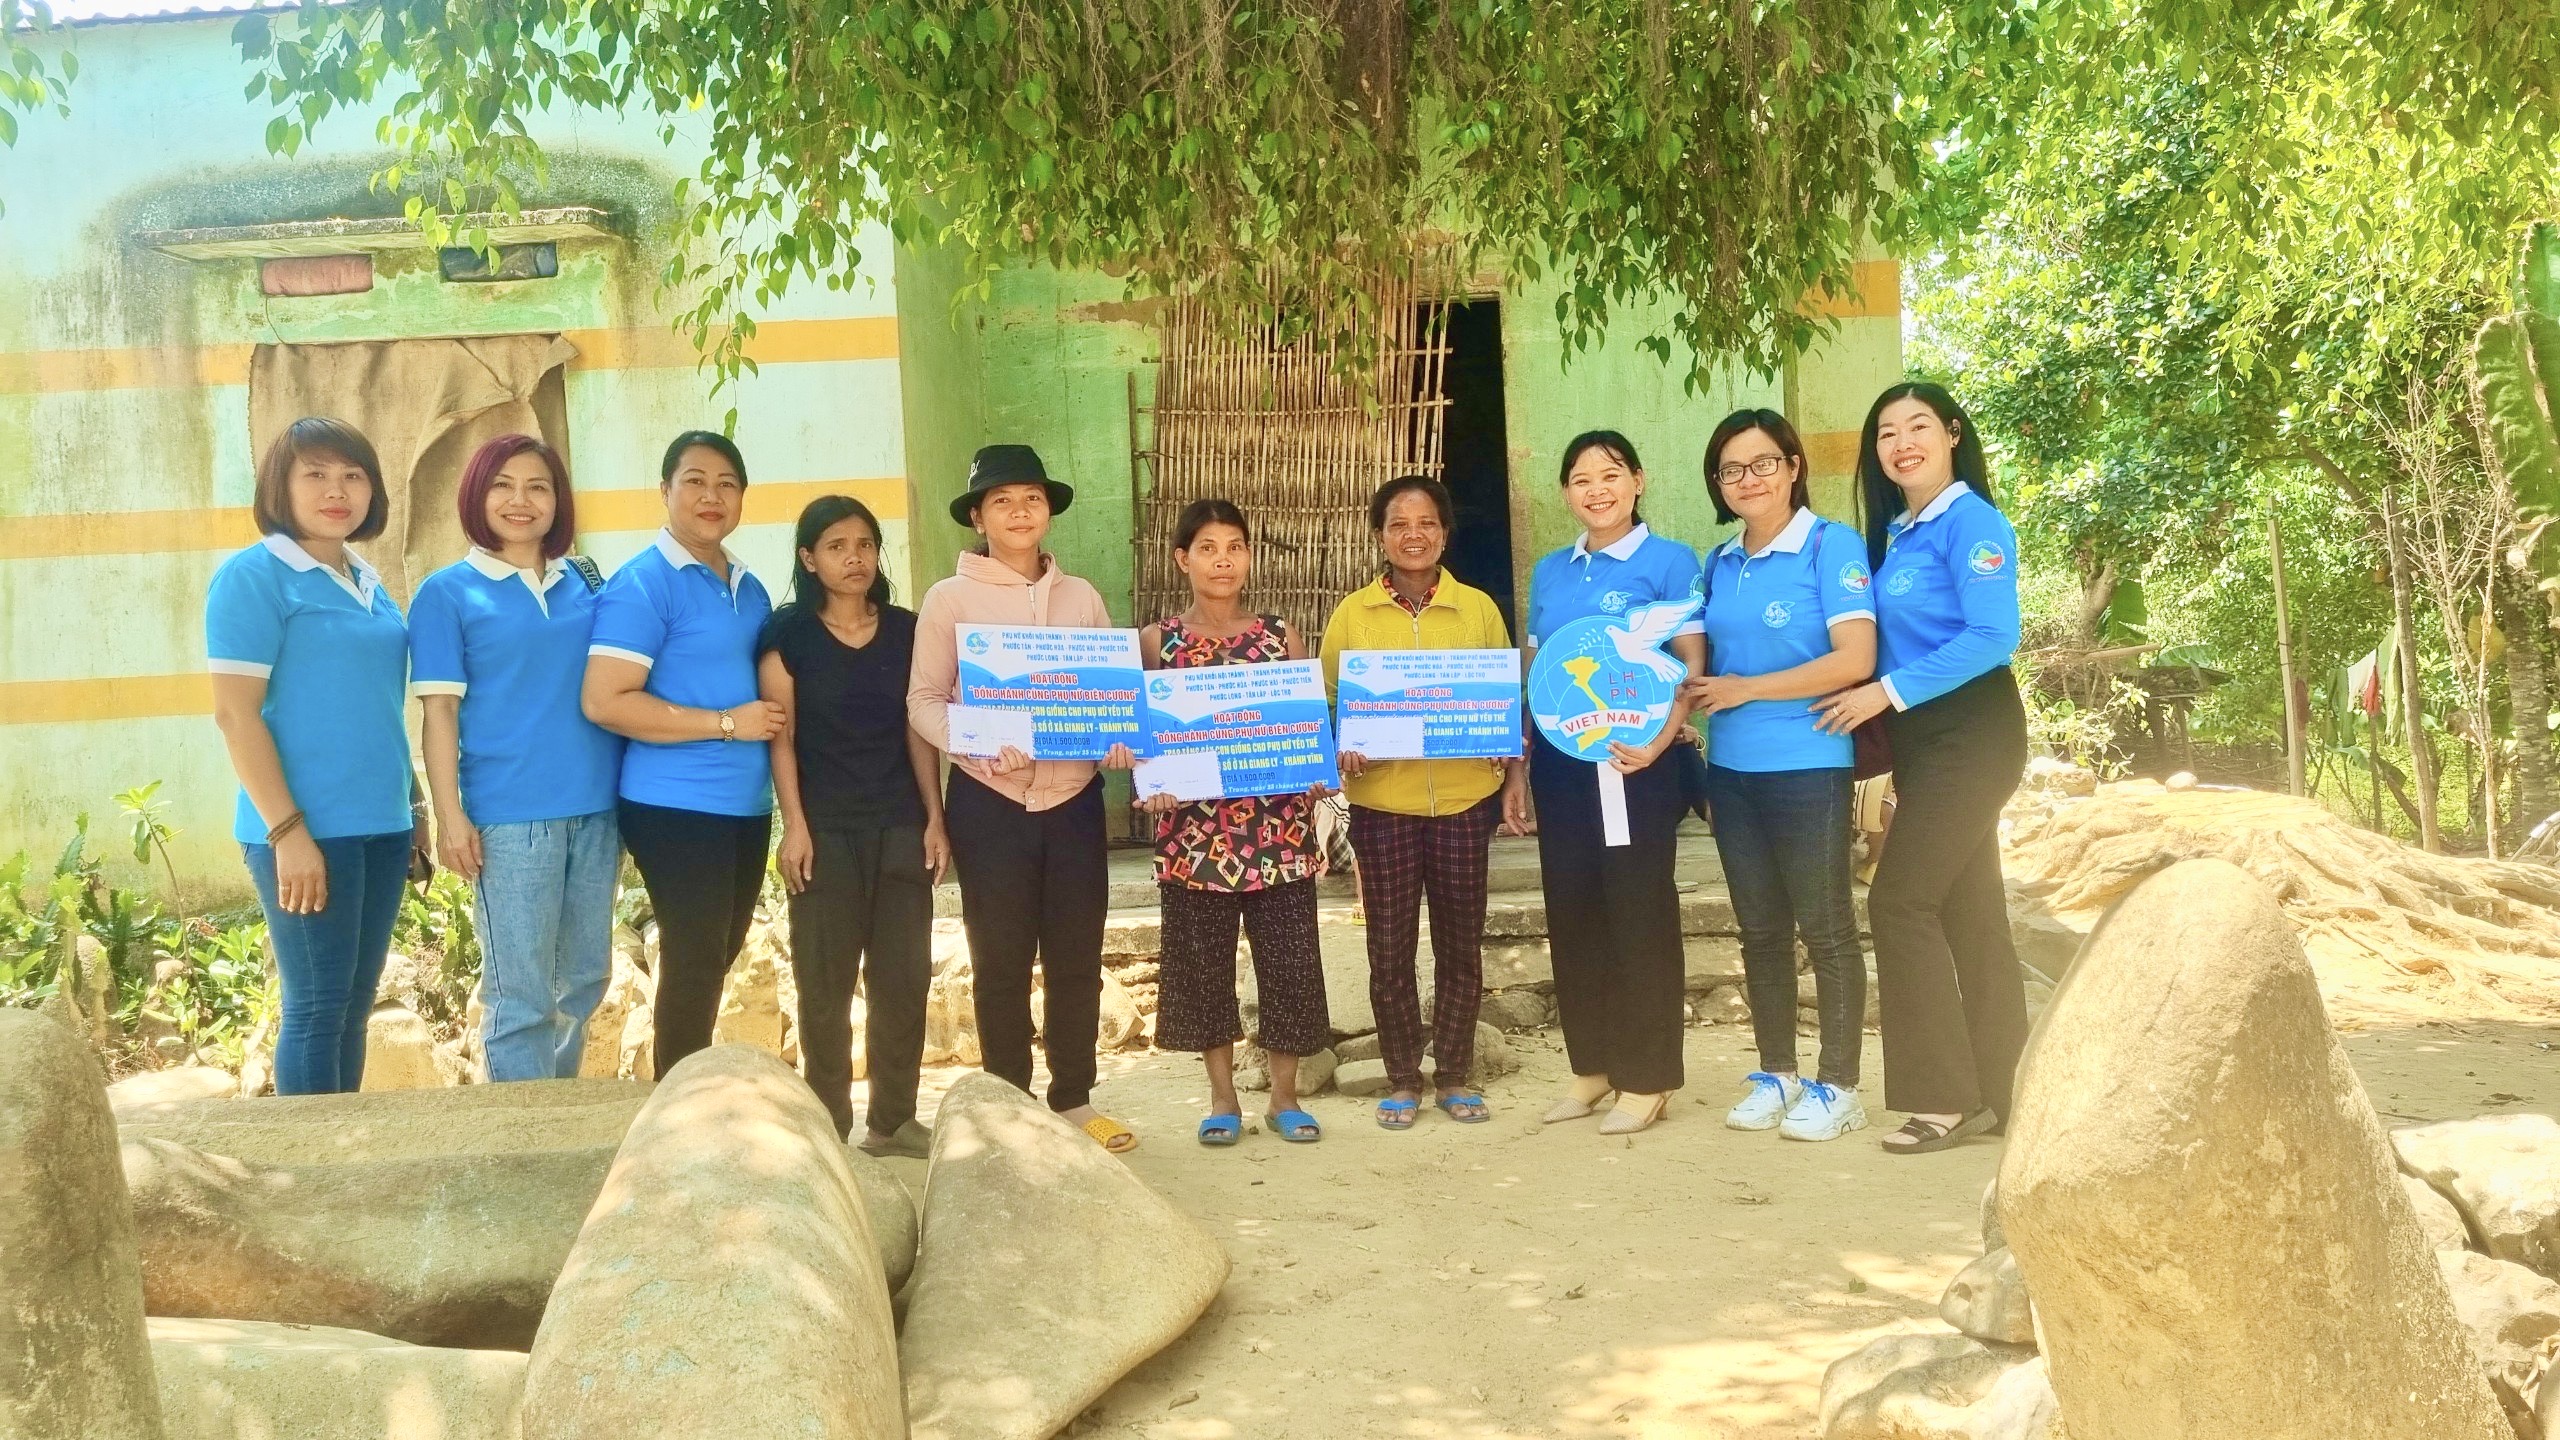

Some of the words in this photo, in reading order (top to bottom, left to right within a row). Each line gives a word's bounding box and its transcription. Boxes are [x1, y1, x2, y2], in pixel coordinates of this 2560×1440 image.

[1030, 674, 1053, 685] HOẠT
[1053, 673, 1078, 686] ĐỘNG
[999, 687, 1024, 699] HÀNH
[1051, 690, 1069, 702] PHỤ
[1084, 689, 1105, 700] BIÊN
[1405, 689, 1427, 698] HOẠT
[1428, 688, 1452, 698] ĐỘNG
[1068, 706, 1082, 716] CHO
[1374, 700, 1397, 710] HÀNH
[1424, 701, 1441, 711] PHỤ
[1458, 700, 1478, 709] BIÊN
[1213, 712, 1236, 725] HOẠT
[1237, 709, 1262, 723] ĐỘNG
[1440, 715, 1452, 723] CHO
[1606, 712, 1640, 725] NAM
[1064, 722, 1086, 732] GIANG
[1184, 728, 1209, 742] HÀNH
[1235, 727, 1253, 740] PHỤ
[1268, 722, 1289, 735] BIÊN
[1434, 727, 1454, 736] GIANG
[1252, 742, 1266, 753] CHO
[1249, 758, 1270, 769] GIANG
